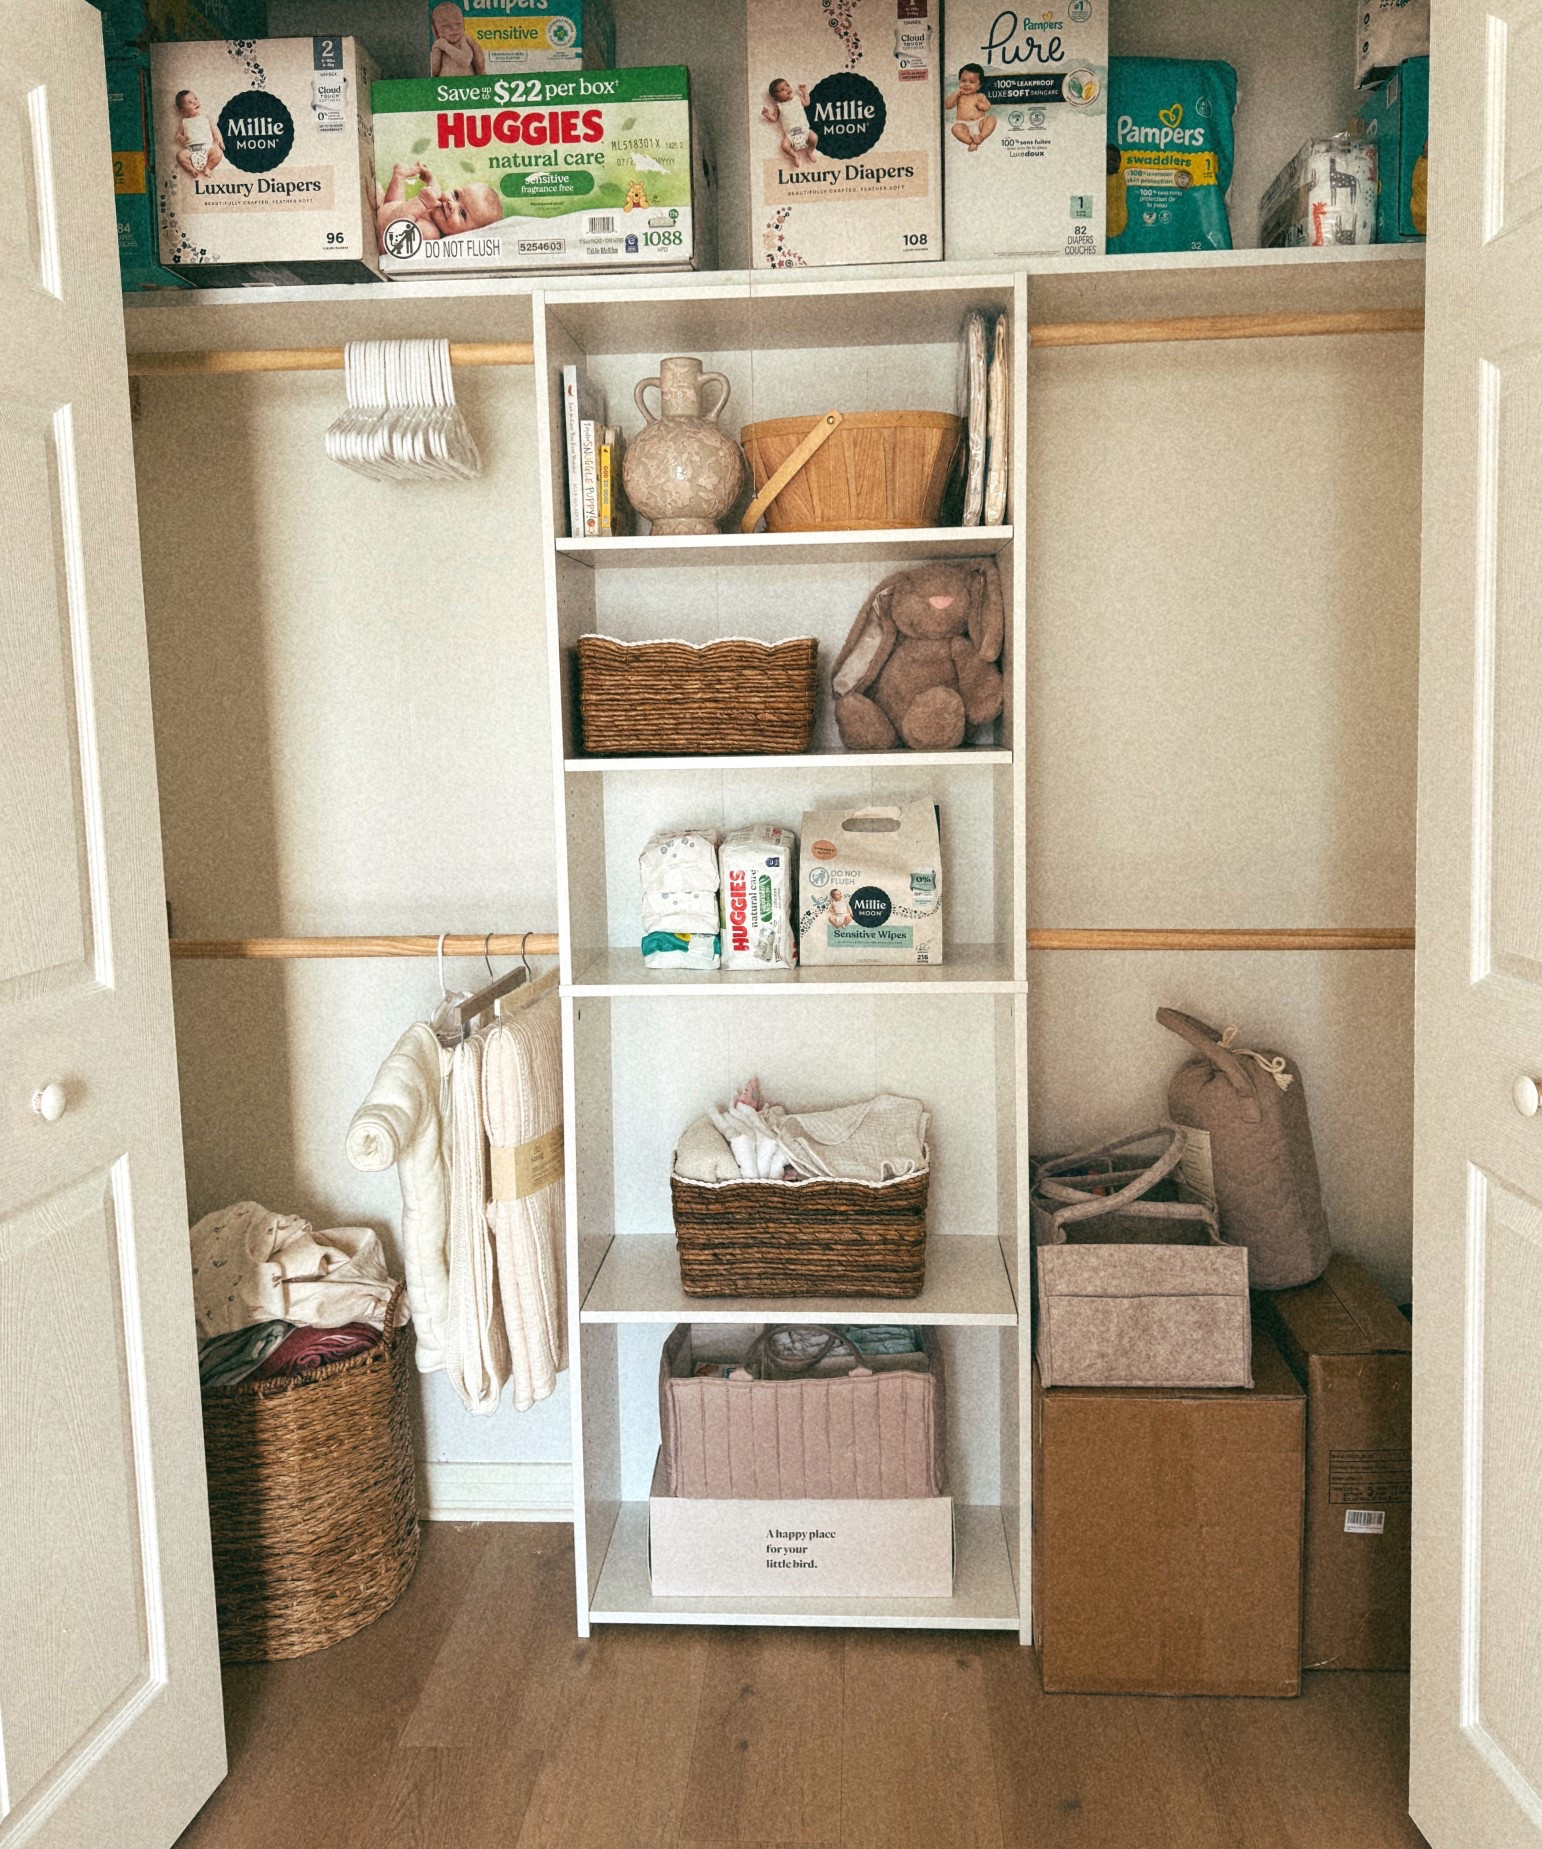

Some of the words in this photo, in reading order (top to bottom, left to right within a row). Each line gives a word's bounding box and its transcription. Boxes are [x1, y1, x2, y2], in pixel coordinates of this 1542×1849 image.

[1024, 18, 1064, 32] Pampers
[477, 26, 538, 40] sensitive
[981, 10, 1064, 64] Pure
[322, 41, 334, 56] 2
[438, 86, 480, 101] Save
[494, 79, 542, 106] $22
[545, 83, 576, 101] per
[814, 100, 876, 122] Millie
[228, 117, 284, 136] Millie
[437, 110, 604, 149] HUGGIES
[1118, 116, 1205, 150] Pampers
[488, 150, 559, 168] natural
[564, 152, 604, 165] care
[1126, 156, 1192, 166] swaddlers
[1206, 159, 1210, 170] 1
[778, 169, 841, 185] Luxury
[846, 164, 914, 183] Diapers
[195, 180, 254, 197] Luxury
[258, 178, 322, 196] Diapers
[522, 186, 558, 194] fragrance
[1078, 196, 1084, 209] 1
[1074, 226, 1086, 234] 82
[326, 232, 344, 244] 96
[642, 230, 682, 246] 1088
[903, 234, 928, 246] 108
[1068, 236, 1094, 244] DIAPERS
[425, 242, 440, 258] DO
[443, 240, 464, 258] NOT
[467, 240, 500, 256] FLUSH
[520, 242, 562, 250] 5254603
[1064, 246, 1096, 254] COUCHES
[1192, 242, 1202, 250] 32
[584, 441, 594, 484] SNUGGLE
[585, 487, 596, 519] PUPPY!
[730, 870, 750, 951] HUGGIES
[749, 893, 758, 928] natural
[854, 900, 886, 910] Millie
[834, 930, 876, 938] Sensitive
[878, 930, 906, 940] Wipes
[766, 1530, 774, 1538] A
[776, 1530, 808, 1540] happy
[809, 1530, 836, 1540] place
[766, 1544, 782, 1554] for
[784, 1546, 808, 1556] your
[766, 1560, 792, 1568] little
[793, 1560, 818, 1568] bird.
